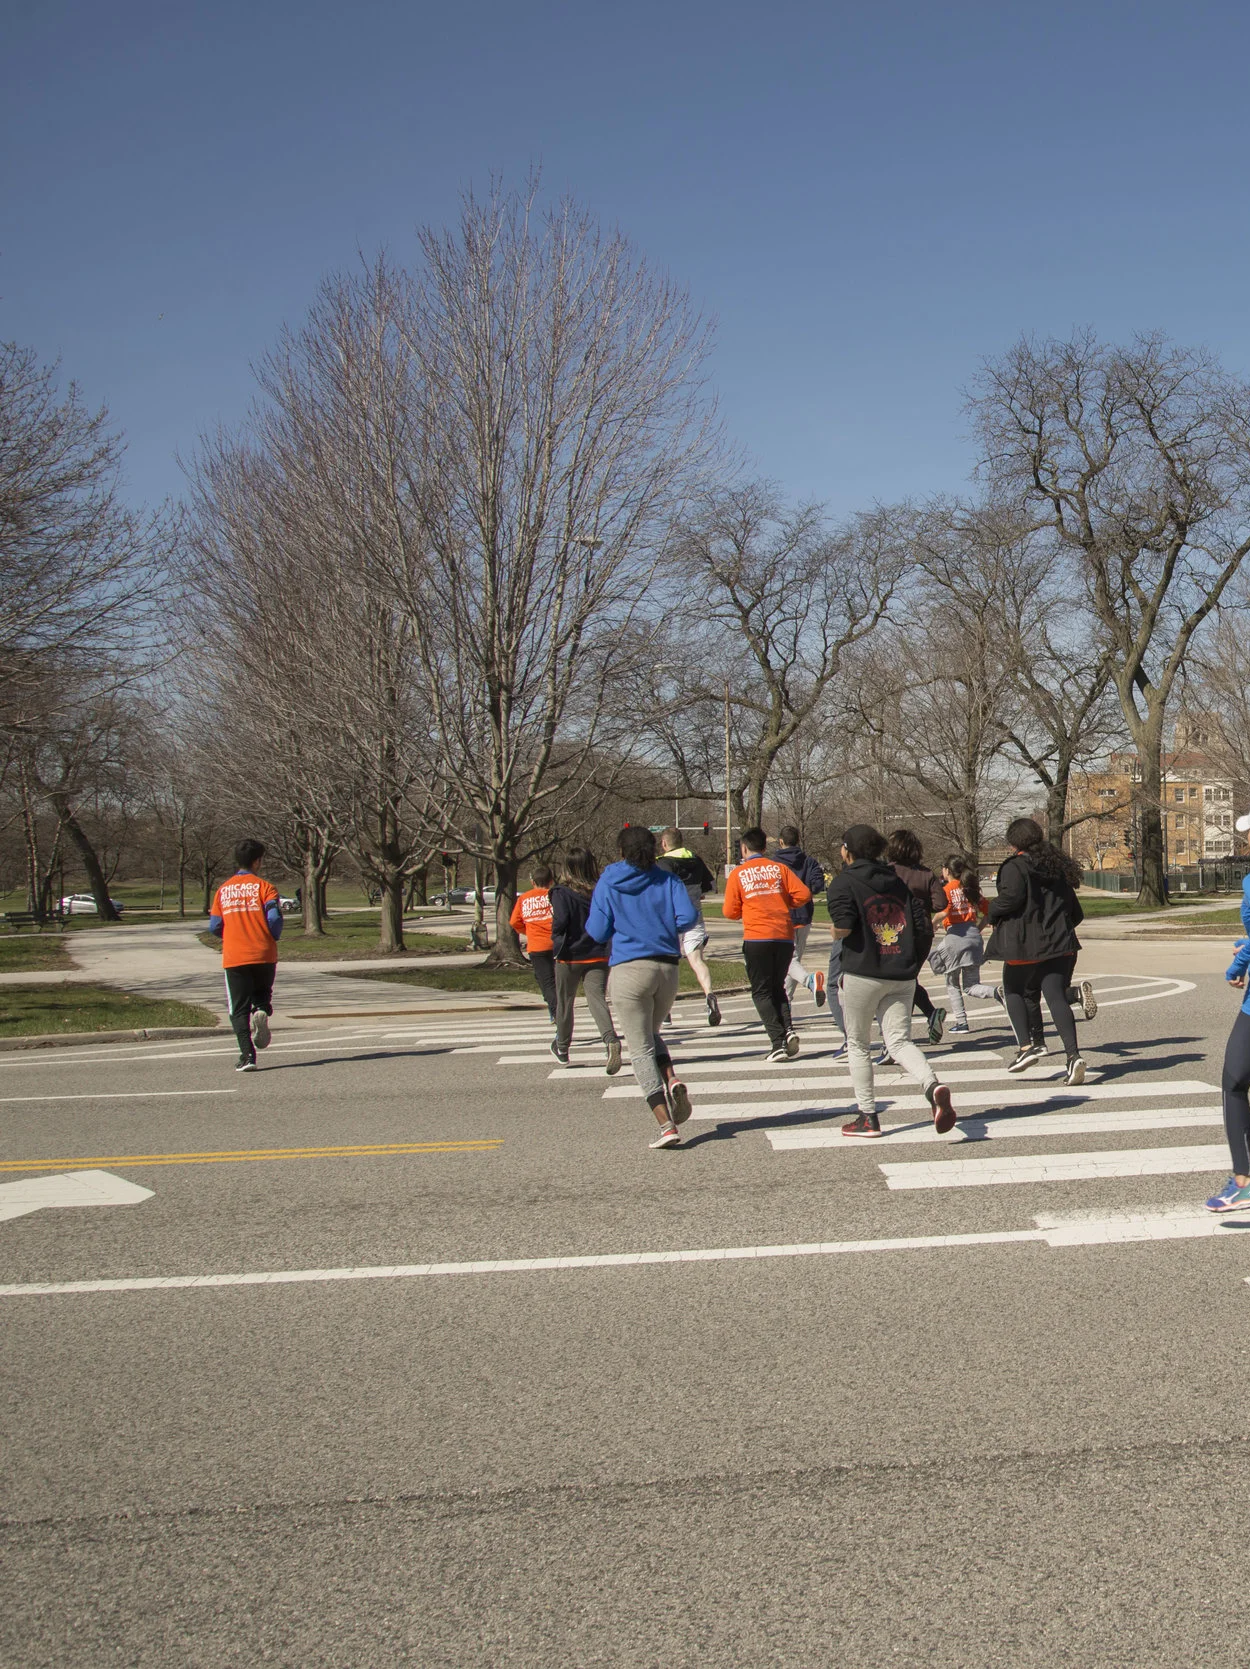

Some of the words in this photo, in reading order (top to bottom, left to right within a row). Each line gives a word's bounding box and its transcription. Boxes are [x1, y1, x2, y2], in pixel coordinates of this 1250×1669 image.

[738, 865, 780, 878] CHICAGO
[740, 872, 782, 886] RUNNING
[220, 883, 260, 893] CHICAGO
[743, 882, 769, 892] Mates
